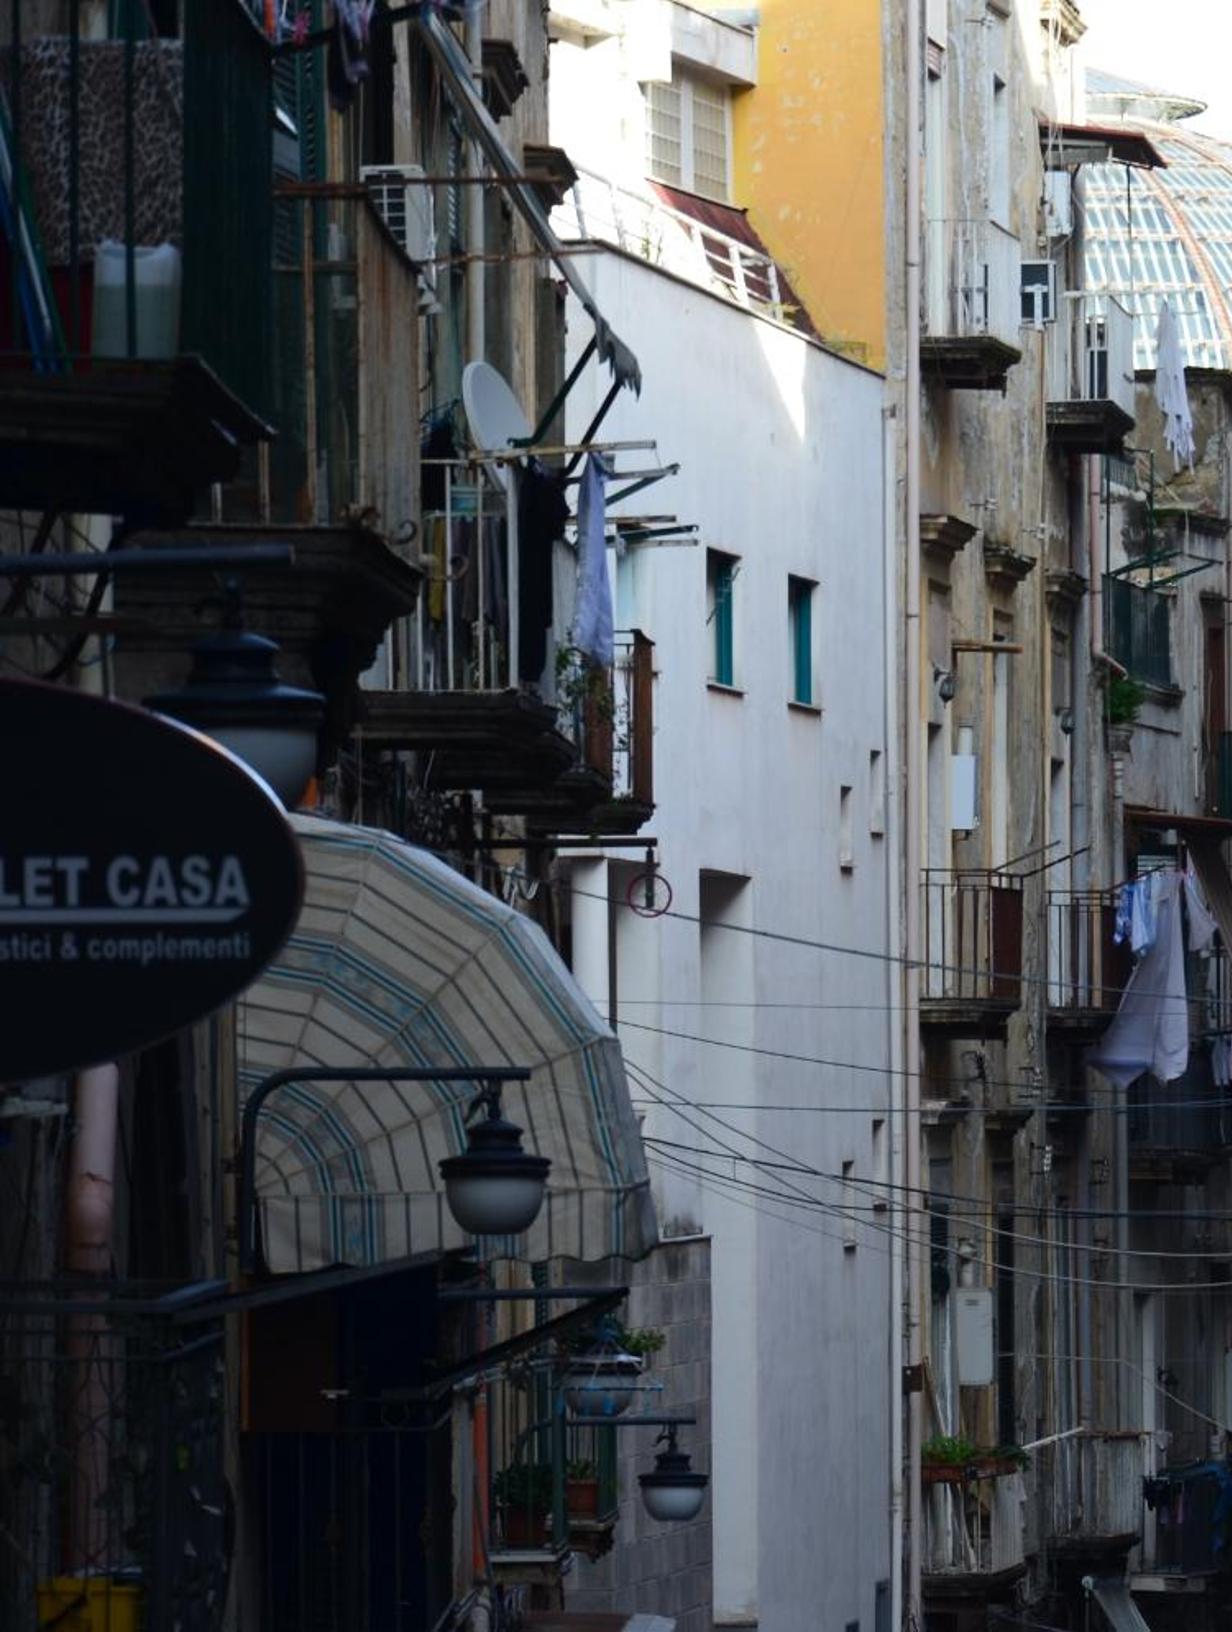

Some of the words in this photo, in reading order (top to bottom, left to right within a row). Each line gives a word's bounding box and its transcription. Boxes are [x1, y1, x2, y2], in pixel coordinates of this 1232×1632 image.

[0, 856, 90, 907] LET
[106, 854, 250, 907] CASA
[60, 931, 79, 960] &
[87, 931, 251, 967] complementi
